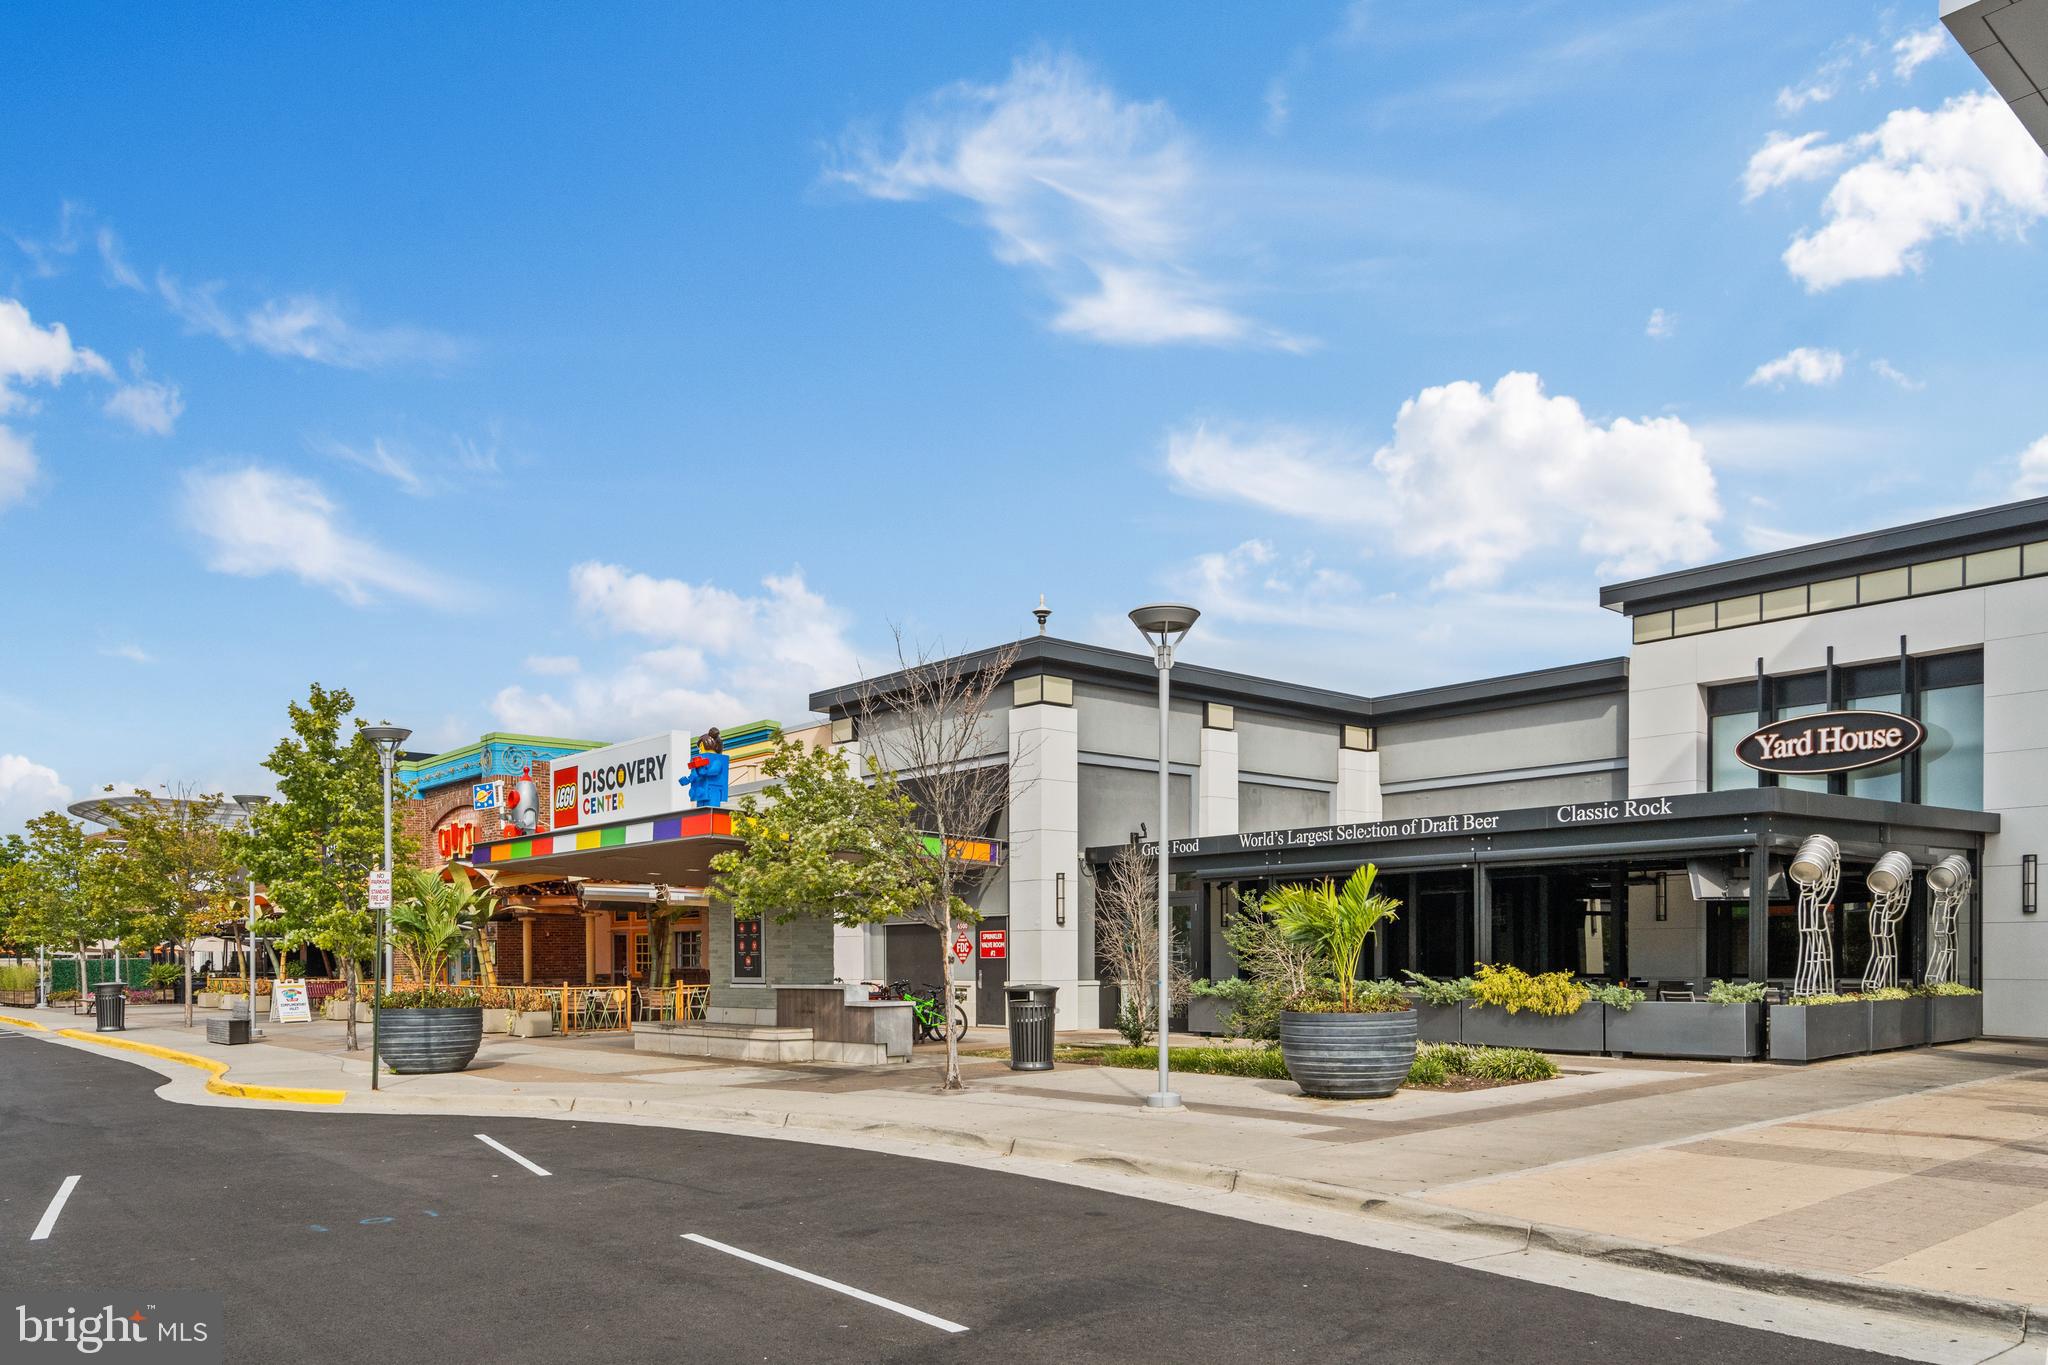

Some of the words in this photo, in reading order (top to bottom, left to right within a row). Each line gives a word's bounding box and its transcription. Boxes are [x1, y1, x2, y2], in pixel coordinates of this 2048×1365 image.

[1755, 729, 1813, 760] Yard
[1817, 726, 1902, 754] House
[556, 784, 576, 810] LEGO
[583, 792, 625, 815] CENTER
[1557, 802, 1619, 822] Classic
[1624, 798, 1673, 818] Rock
[1239, 831, 1284, 848] World's
[1287, 828, 1334, 846] Largest
[1337, 822, 1398, 841] Selection
[1401, 819, 1418, 836] of
[1420, 815, 1459, 834] Draft
[1463, 814, 1499, 831] Beer
[1172, 839, 1199, 854] Food
[956, 942, 969, 952] FDC
